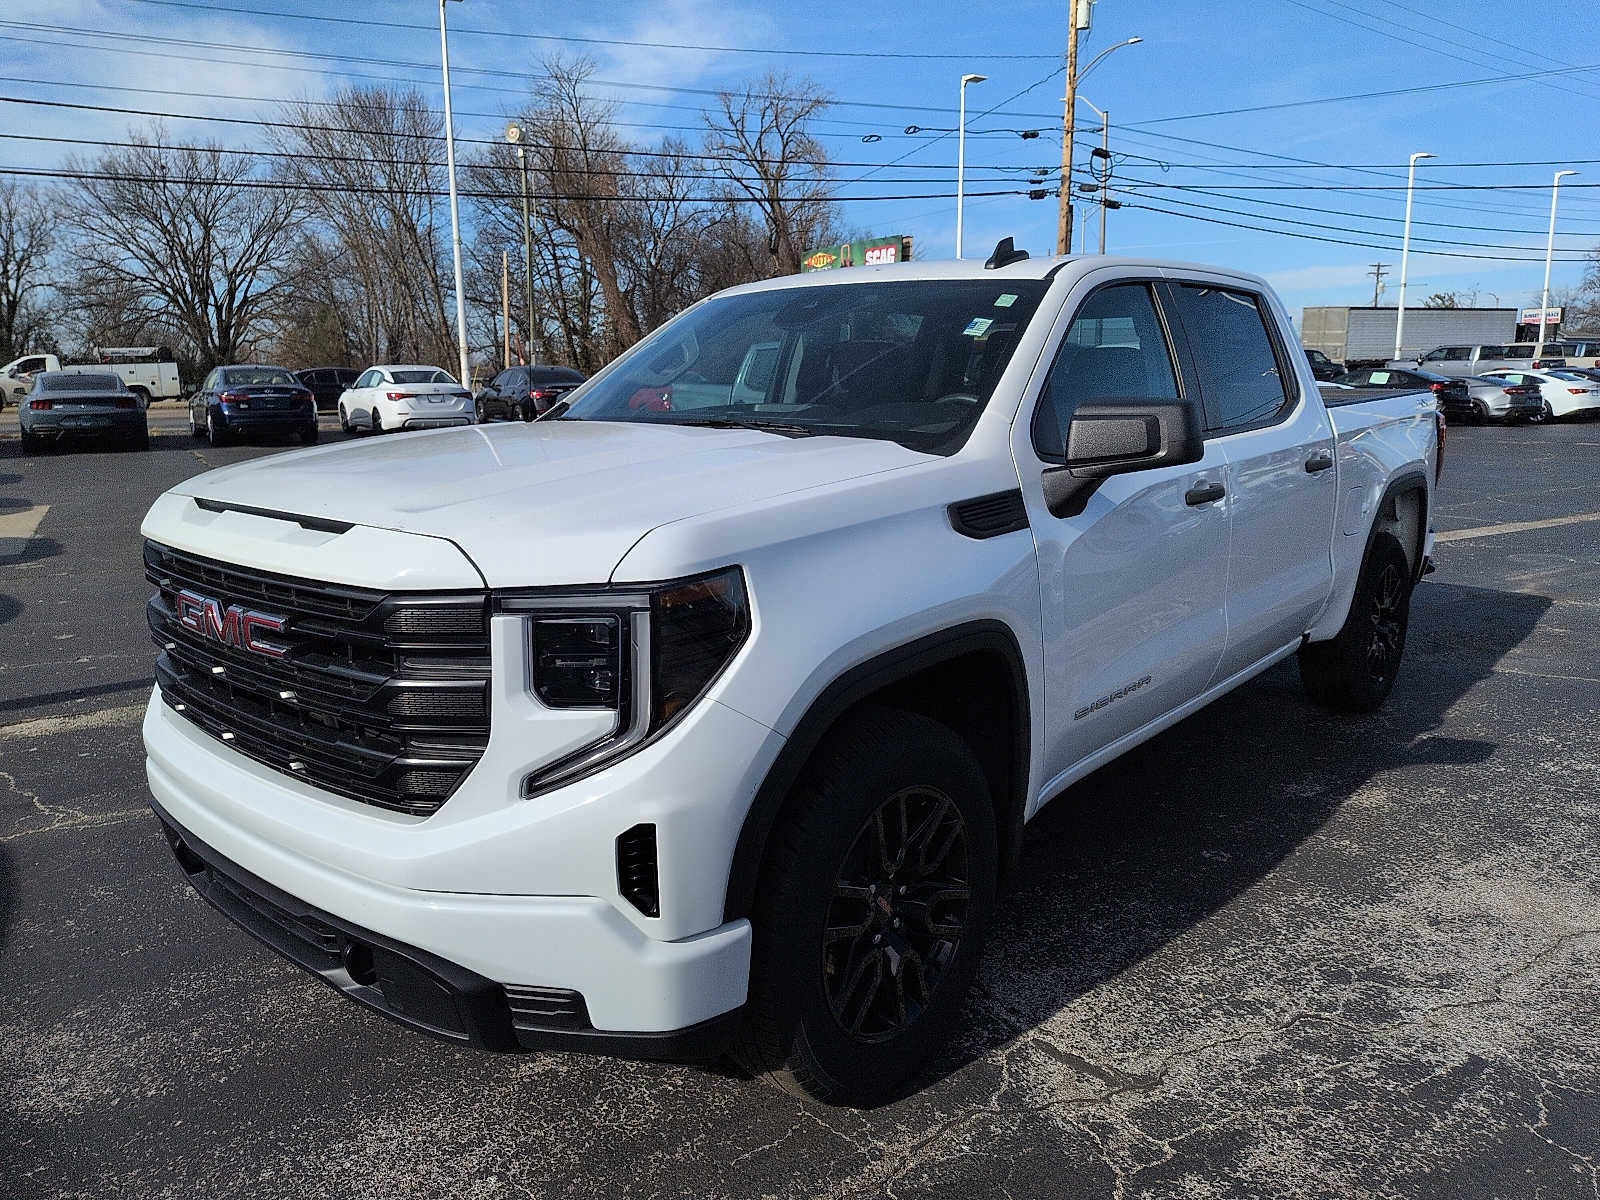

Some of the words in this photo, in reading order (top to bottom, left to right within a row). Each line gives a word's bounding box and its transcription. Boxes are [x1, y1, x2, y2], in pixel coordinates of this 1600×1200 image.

[866, 247, 895, 265] SCAG
[177, 589, 287, 659] GMC
[1073, 674, 1152, 720] SIERRA
